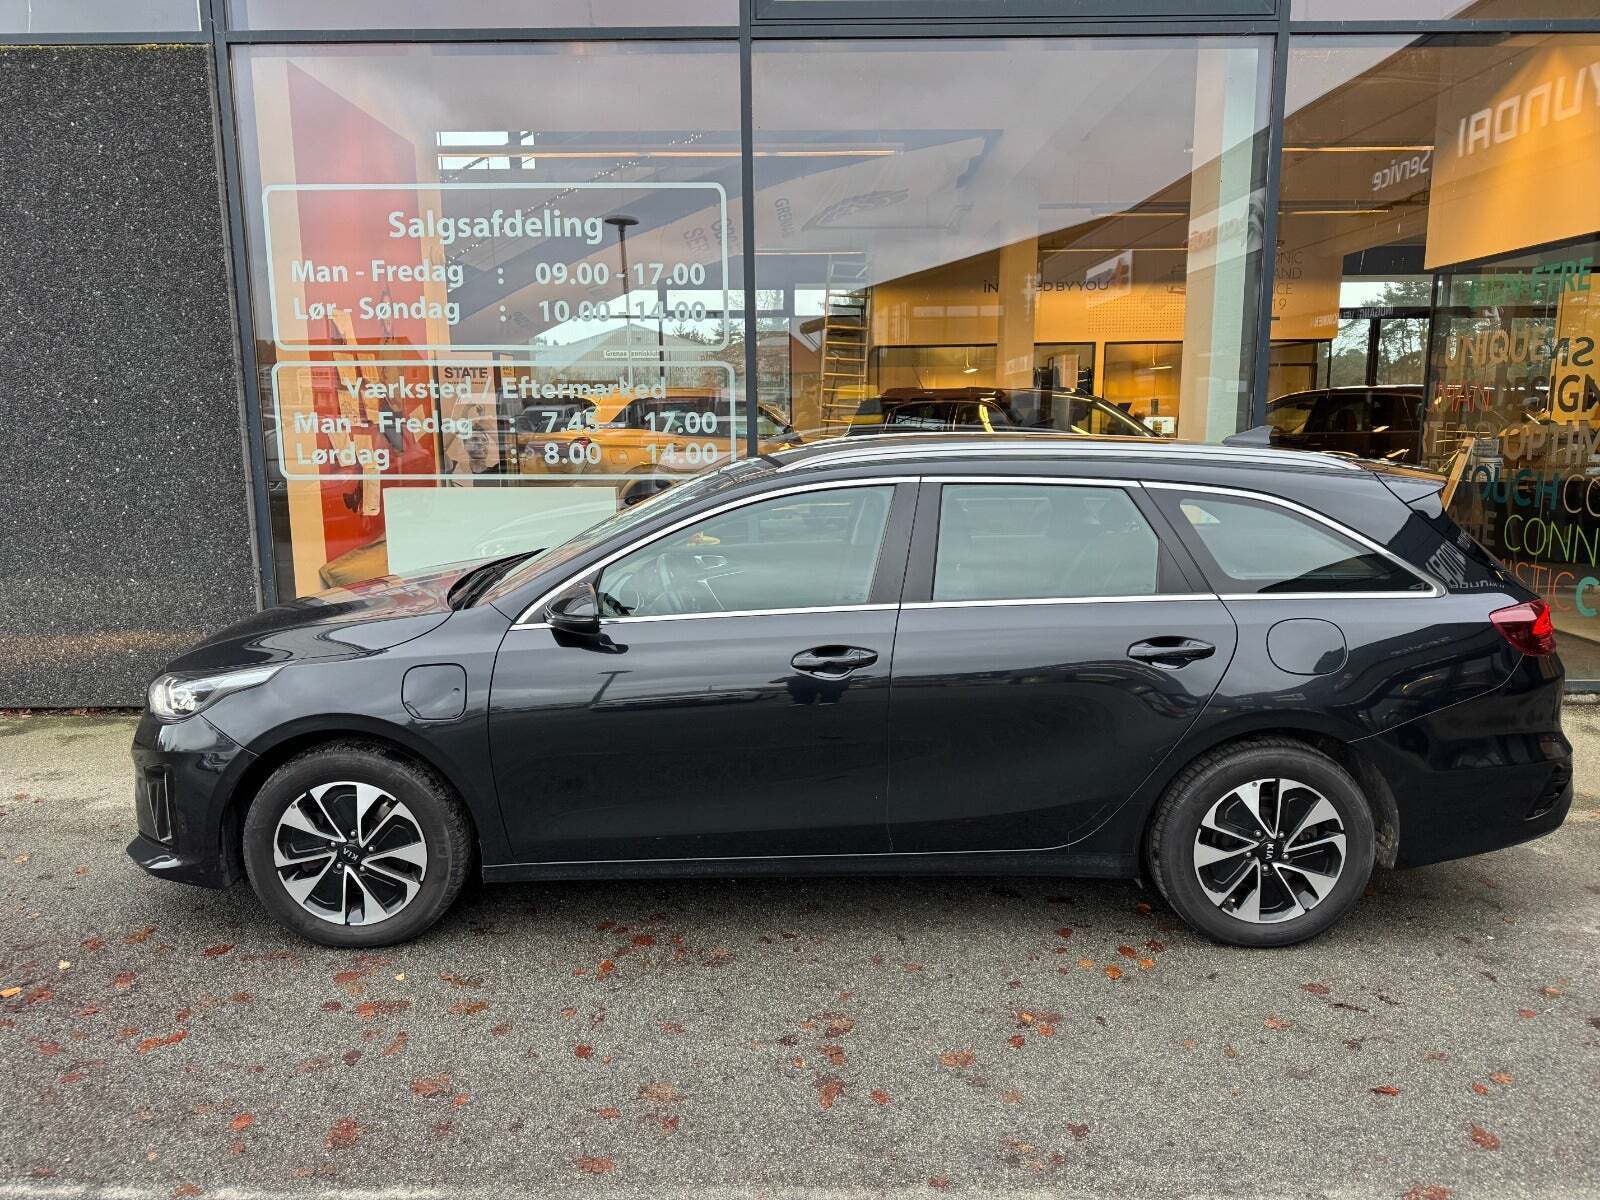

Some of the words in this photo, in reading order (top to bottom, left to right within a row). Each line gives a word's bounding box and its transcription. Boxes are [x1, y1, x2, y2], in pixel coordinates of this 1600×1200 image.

[388, 209, 604, 245] Salgsafdeling
[291, 260, 348, 283] Man
[371, 259, 464, 288] Fredag
[535, 262, 610, 286] 09.00
[633, 262, 706, 286] 17.00
[1076, 280, 1109, 292] YOU
[293, 297, 337, 320] Lør
[359, 297, 460, 325] Søndag
[538, 300, 612, 323] 10.00
[635, 300, 707, 323] 14.00
[444, 367, 488, 379] STATE
[343, 376, 472, 399] Værksted
[502, 376, 667, 399] Eftermarked
[294, 412, 352, 434] Man
[378, 410, 474, 439] Fredag
[541, 411, 600, 433] 7.45
[645, 411, 718, 434] 17.00
[296, 441, 390, 470] Lørdag
[544, 442, 602, 464] 8.00
[646, 442, 718, 464] 14.00
[342, 847, 359, 861] KIA
[1265, 843, 1274, 860] KIA
